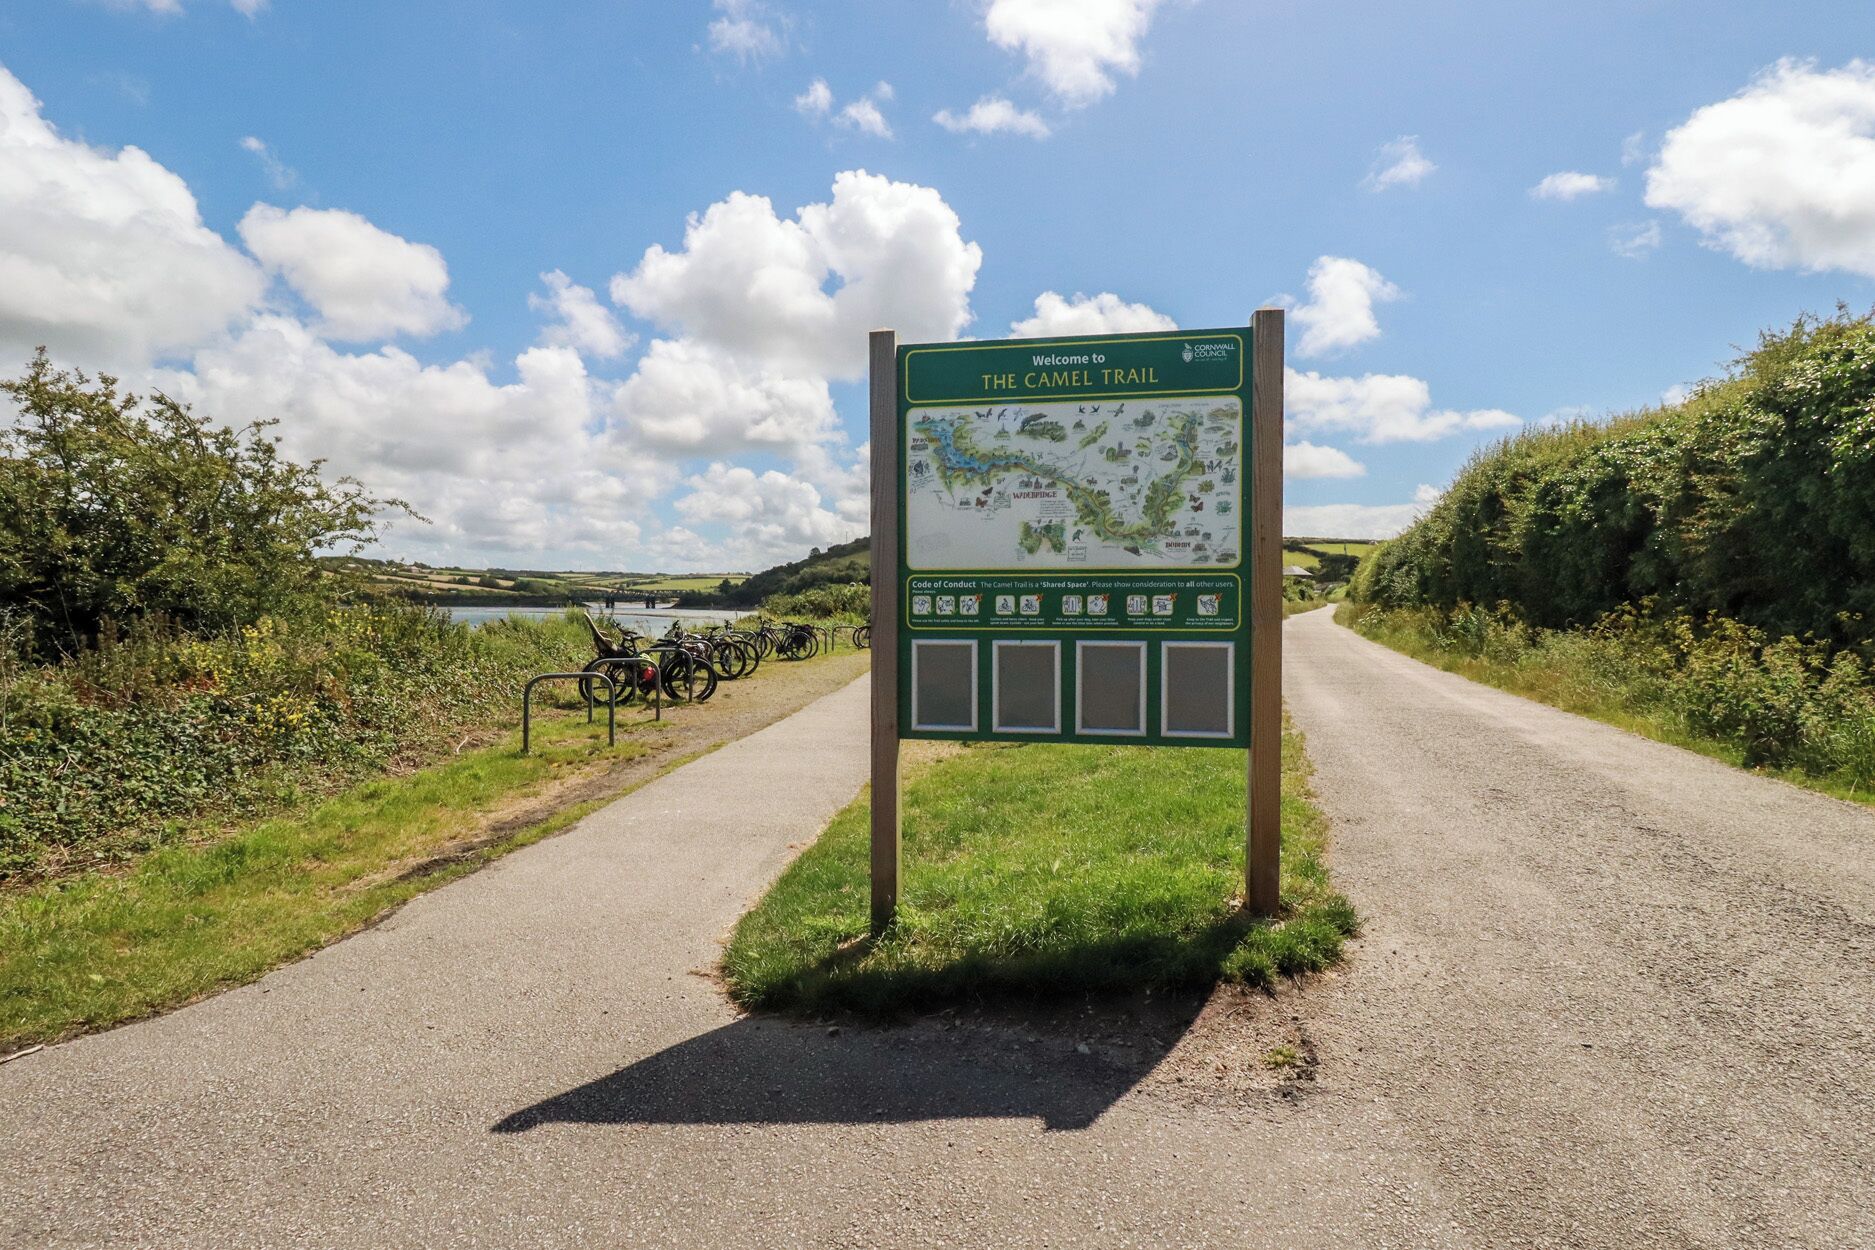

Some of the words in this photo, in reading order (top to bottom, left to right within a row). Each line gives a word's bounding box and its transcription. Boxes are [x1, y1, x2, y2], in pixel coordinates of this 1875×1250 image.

[1194, 343, 1236, 351] CORNWALL
[1194, 350, 1228, 358] COUNCIL
[1032, 353, 1089, 366] Welcome
[1092, 352, 1105, 363] to
[981, 373, 1017, 390] THE
[1024, 370, 1093, 388] CAMEL
[1101, 367, 1159, 385] TRAIL
[912, 580, 932, 588] Code
[933, 580, 942, 588] of
[943, 580, 977, 588] Conduct
